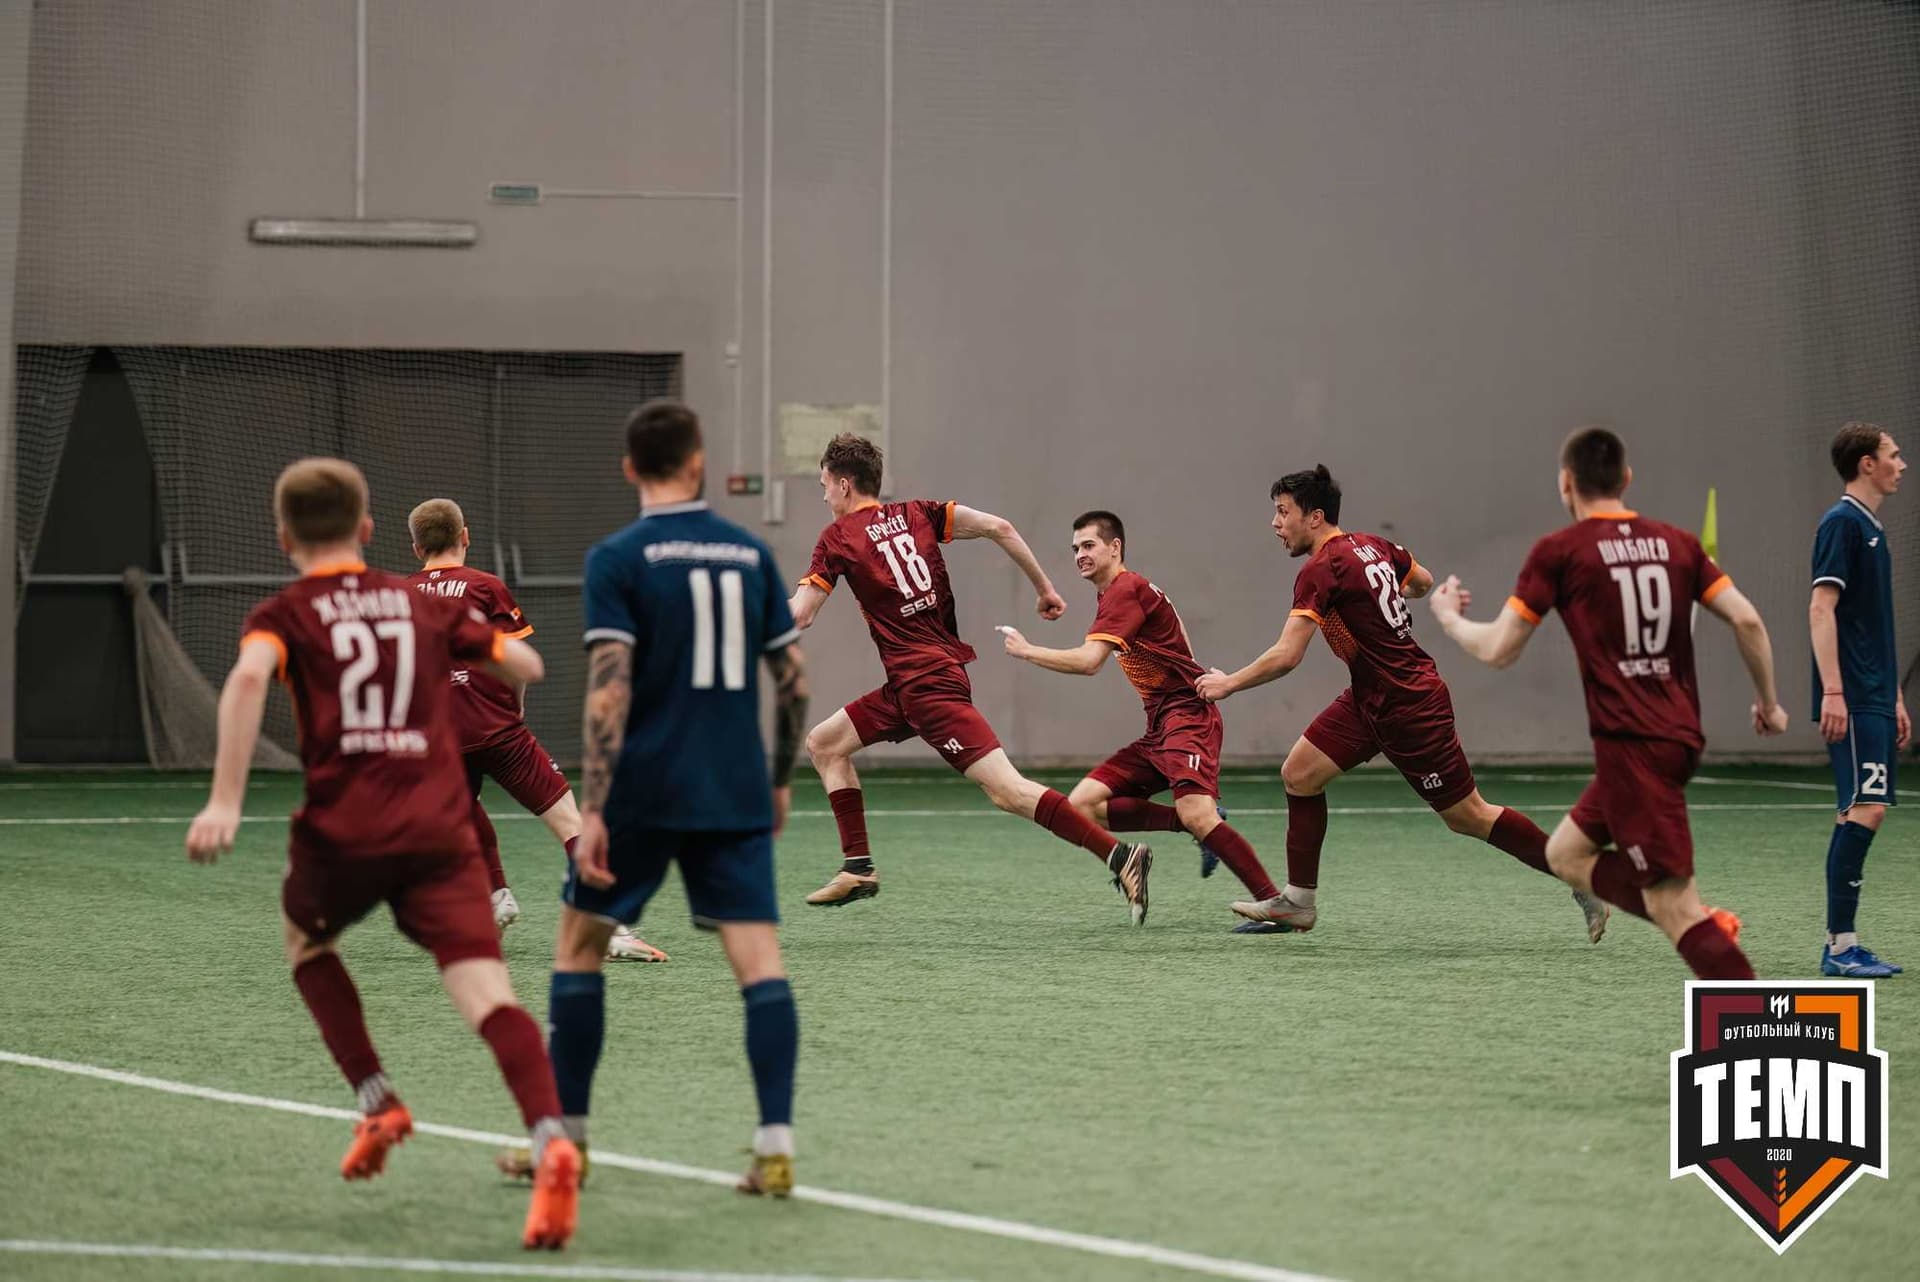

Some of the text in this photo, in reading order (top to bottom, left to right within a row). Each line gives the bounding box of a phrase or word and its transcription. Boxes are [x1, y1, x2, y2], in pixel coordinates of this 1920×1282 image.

[876, 533, 932, 600] 18
[1597, 537, 1670, 565] ШИБАЕВ
[688, 568, 746, 691] 11
[1610, 564, 1672, 656] 19
[331, 621, 415, 729] 27
[1421, 772, 1443, 790] 22
[1861, 762, 1888, 796] 23
